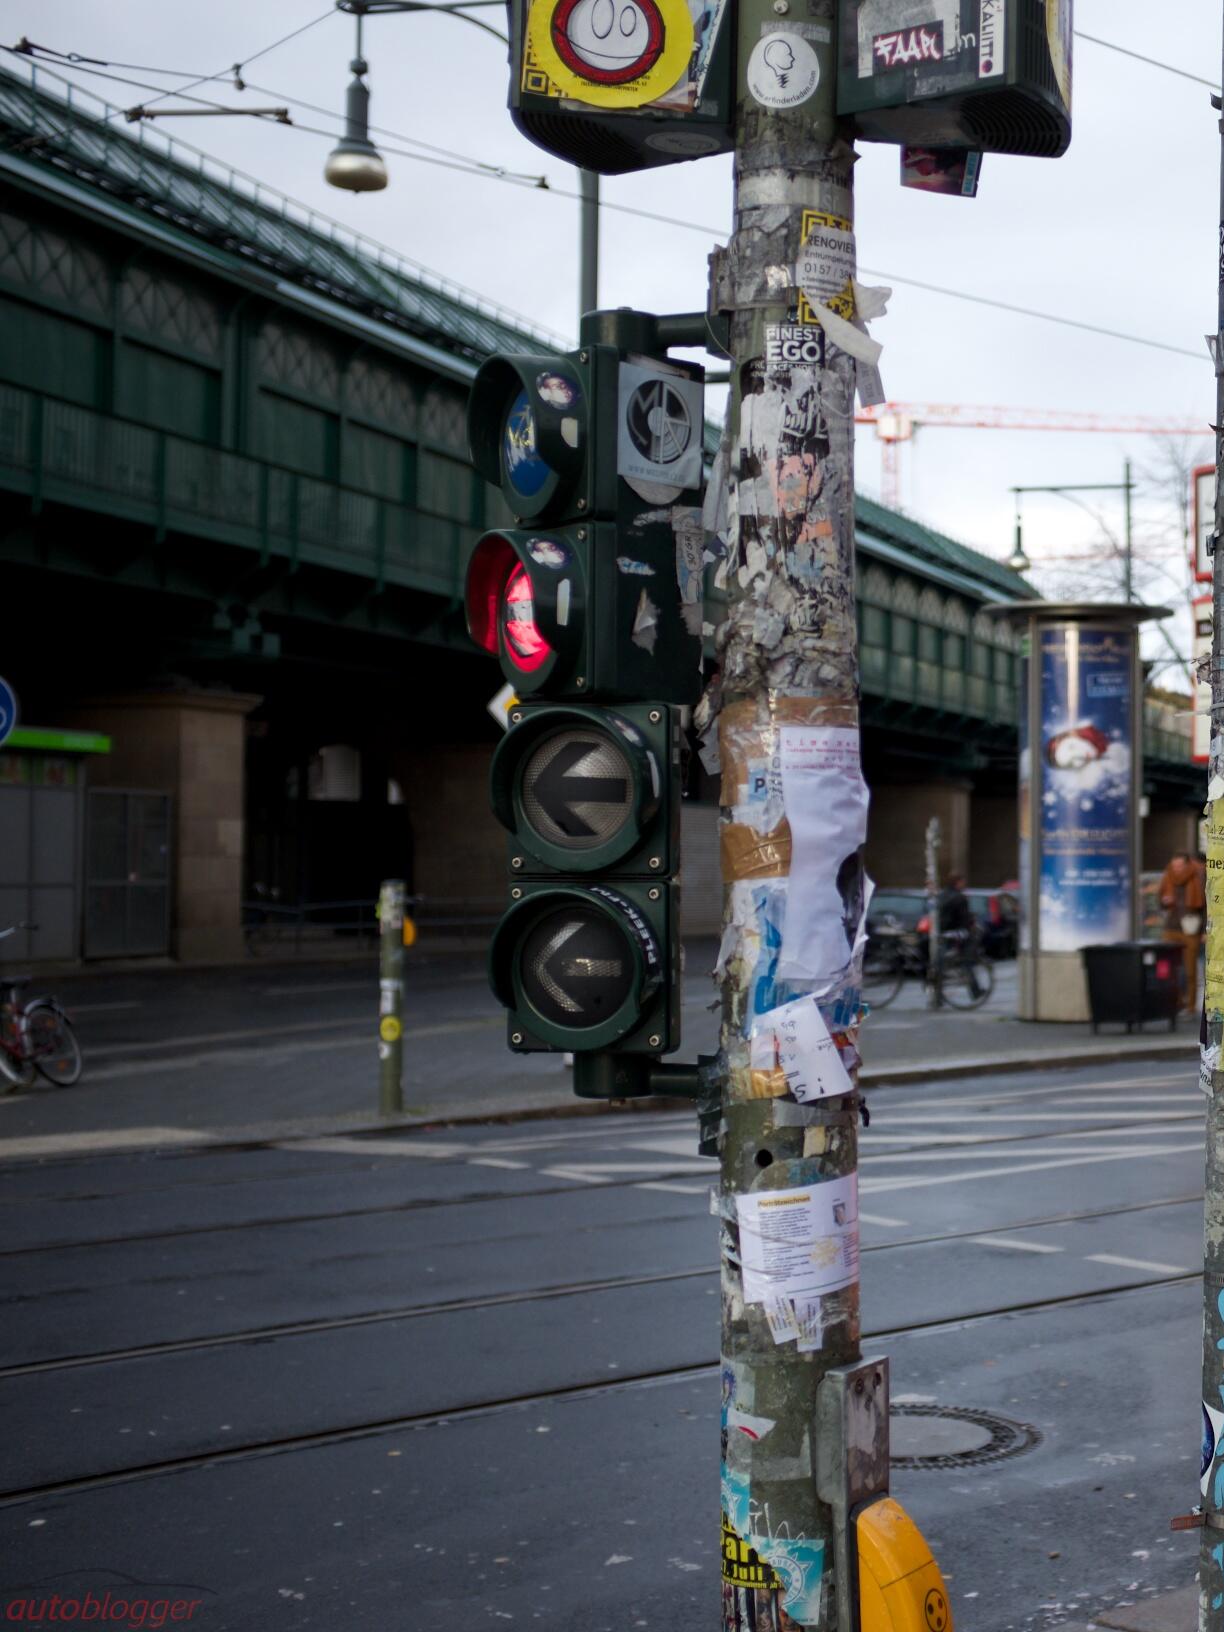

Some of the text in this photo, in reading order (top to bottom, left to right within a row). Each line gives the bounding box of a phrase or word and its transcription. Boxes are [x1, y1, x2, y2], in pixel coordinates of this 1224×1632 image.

[753, 70, 816, 104] www.erfinderladen.com
[804, 262, 831, 275] 0157
[766, 327, 822, 341] FINEST
[766, 341, 821, 362] EGO
[732, 1563, 763, 1581] Juli
